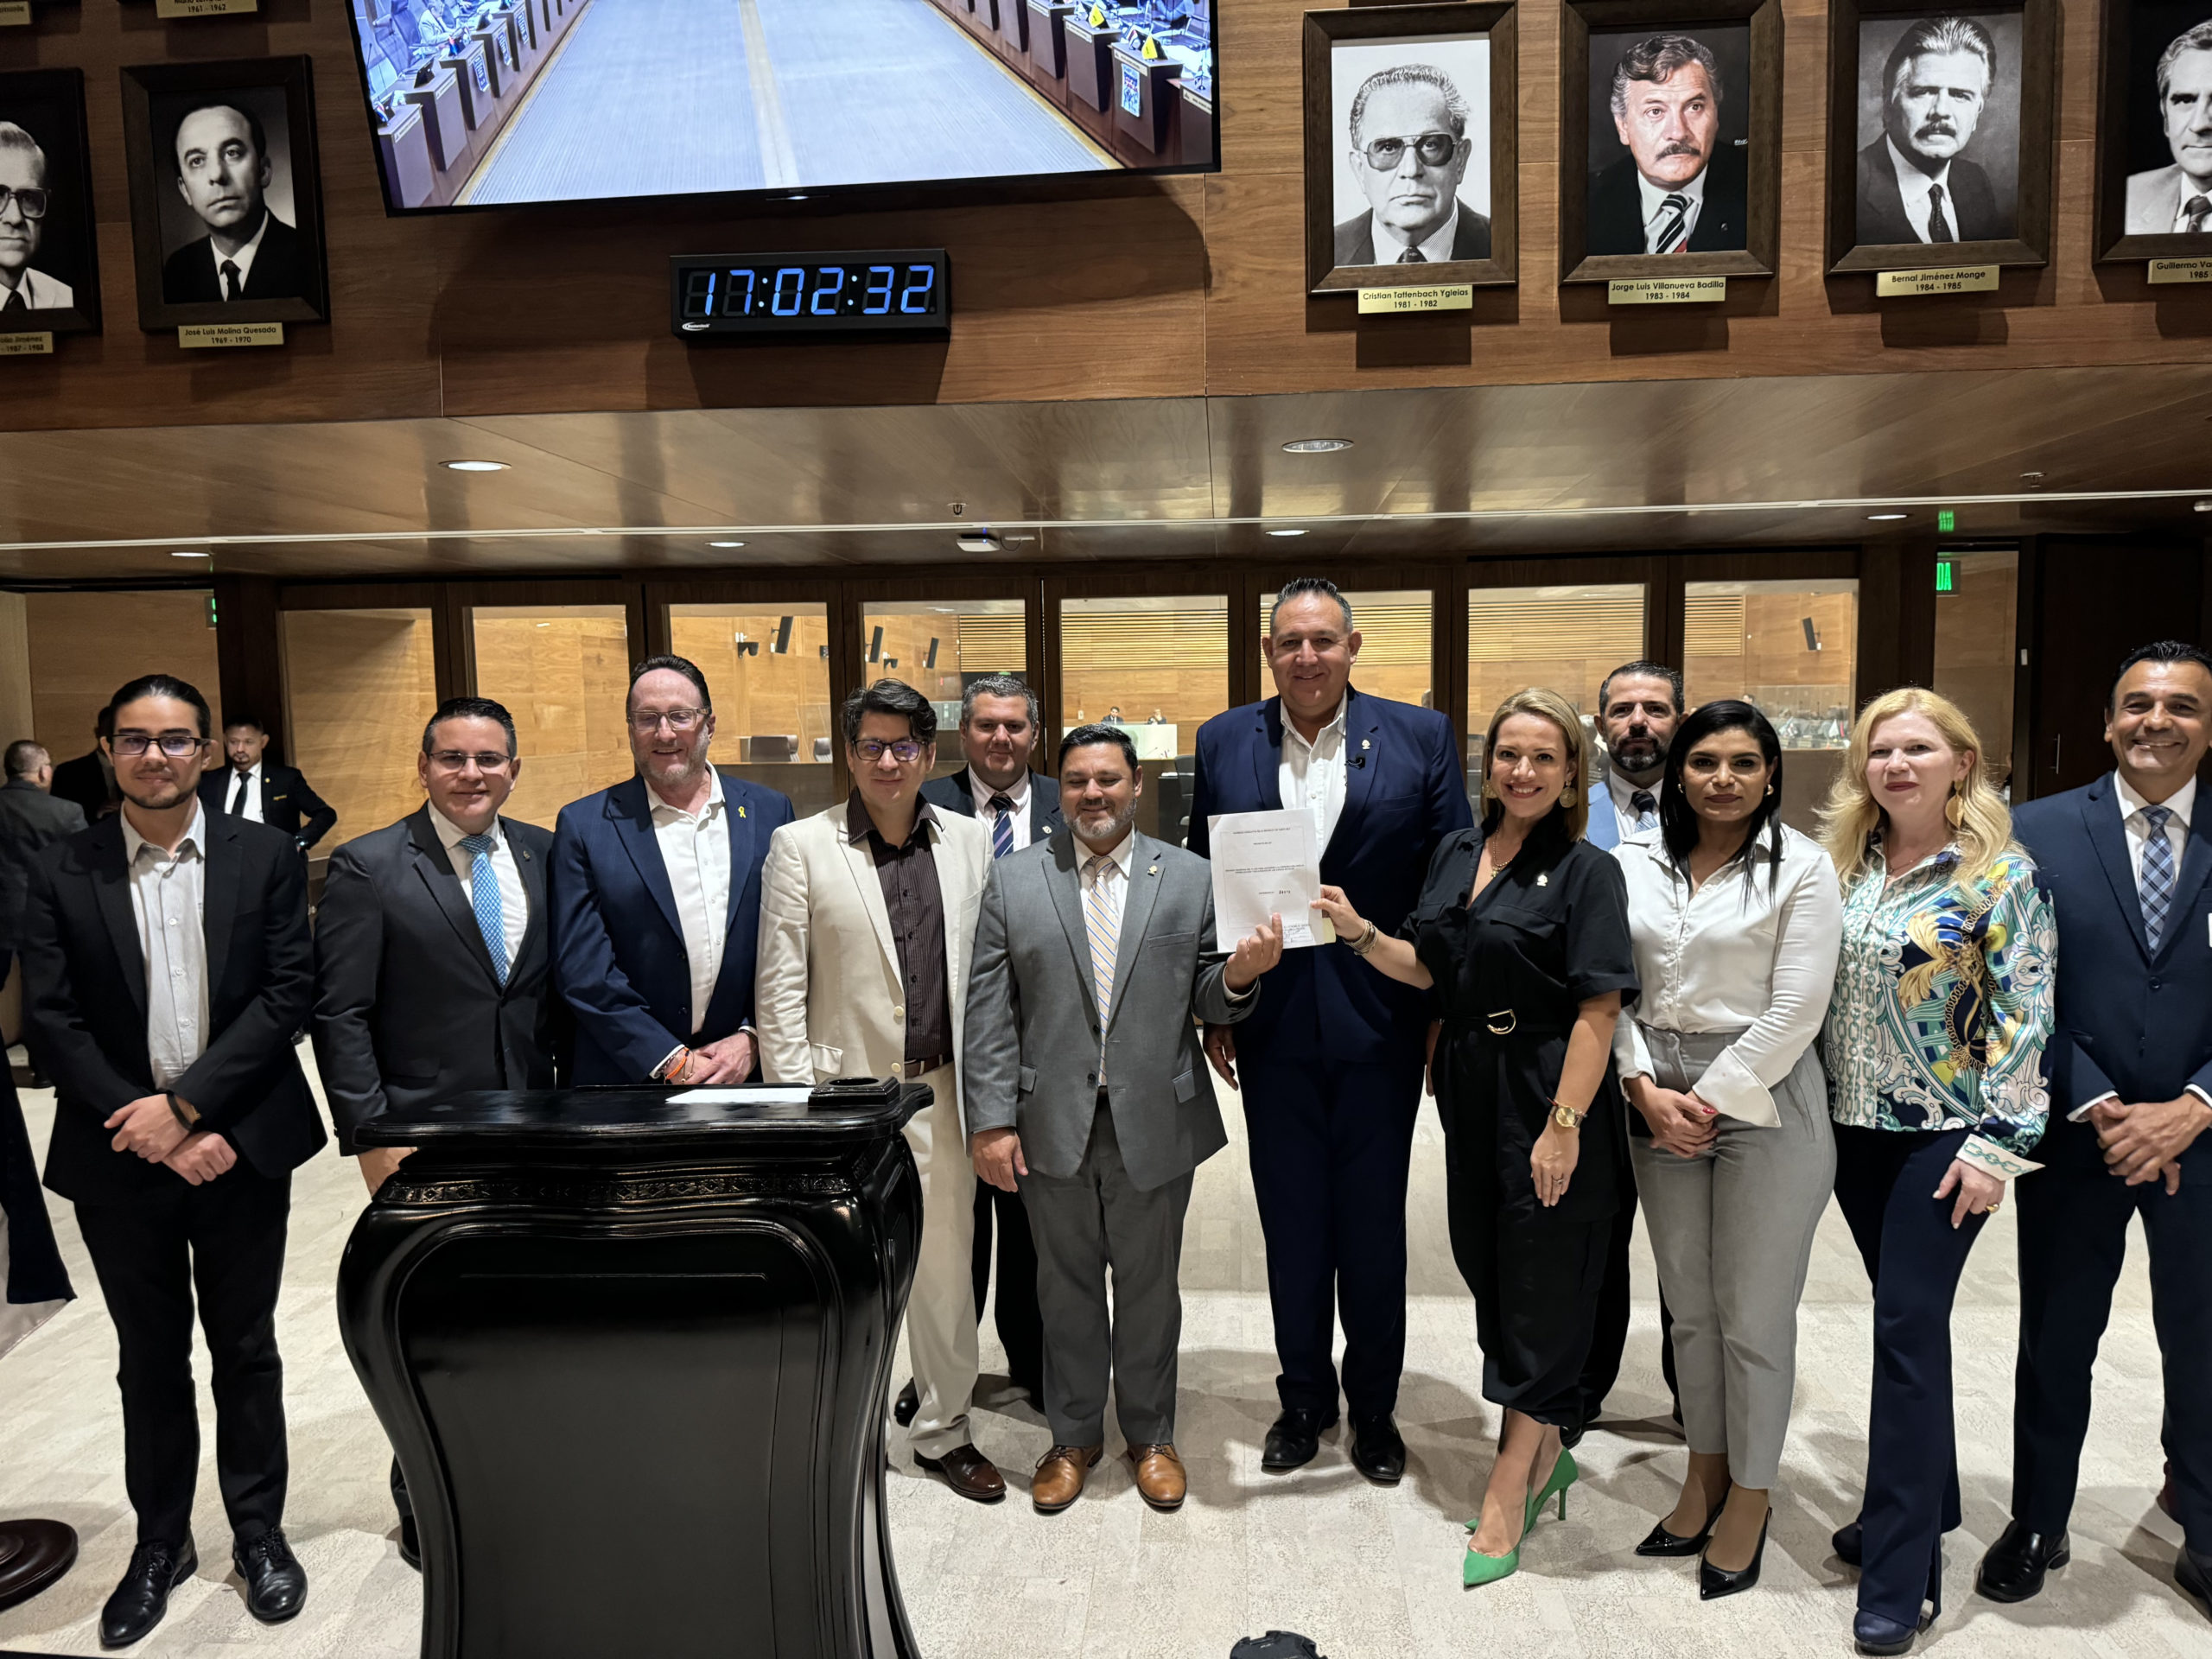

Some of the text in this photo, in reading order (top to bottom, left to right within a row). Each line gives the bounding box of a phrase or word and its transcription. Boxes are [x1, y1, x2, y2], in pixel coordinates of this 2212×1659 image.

[1891, 270, 1986, 283] Bernal Jiménez Monge
[704, 264, 934, 316] 17:02:32
[1611, 283, 1634, 292] Jorge
[1943, 282, 1961, 290] 1985
[1394, 289, 1438, 299] Tattenbach
[217, 327, 242, 335] Molina
